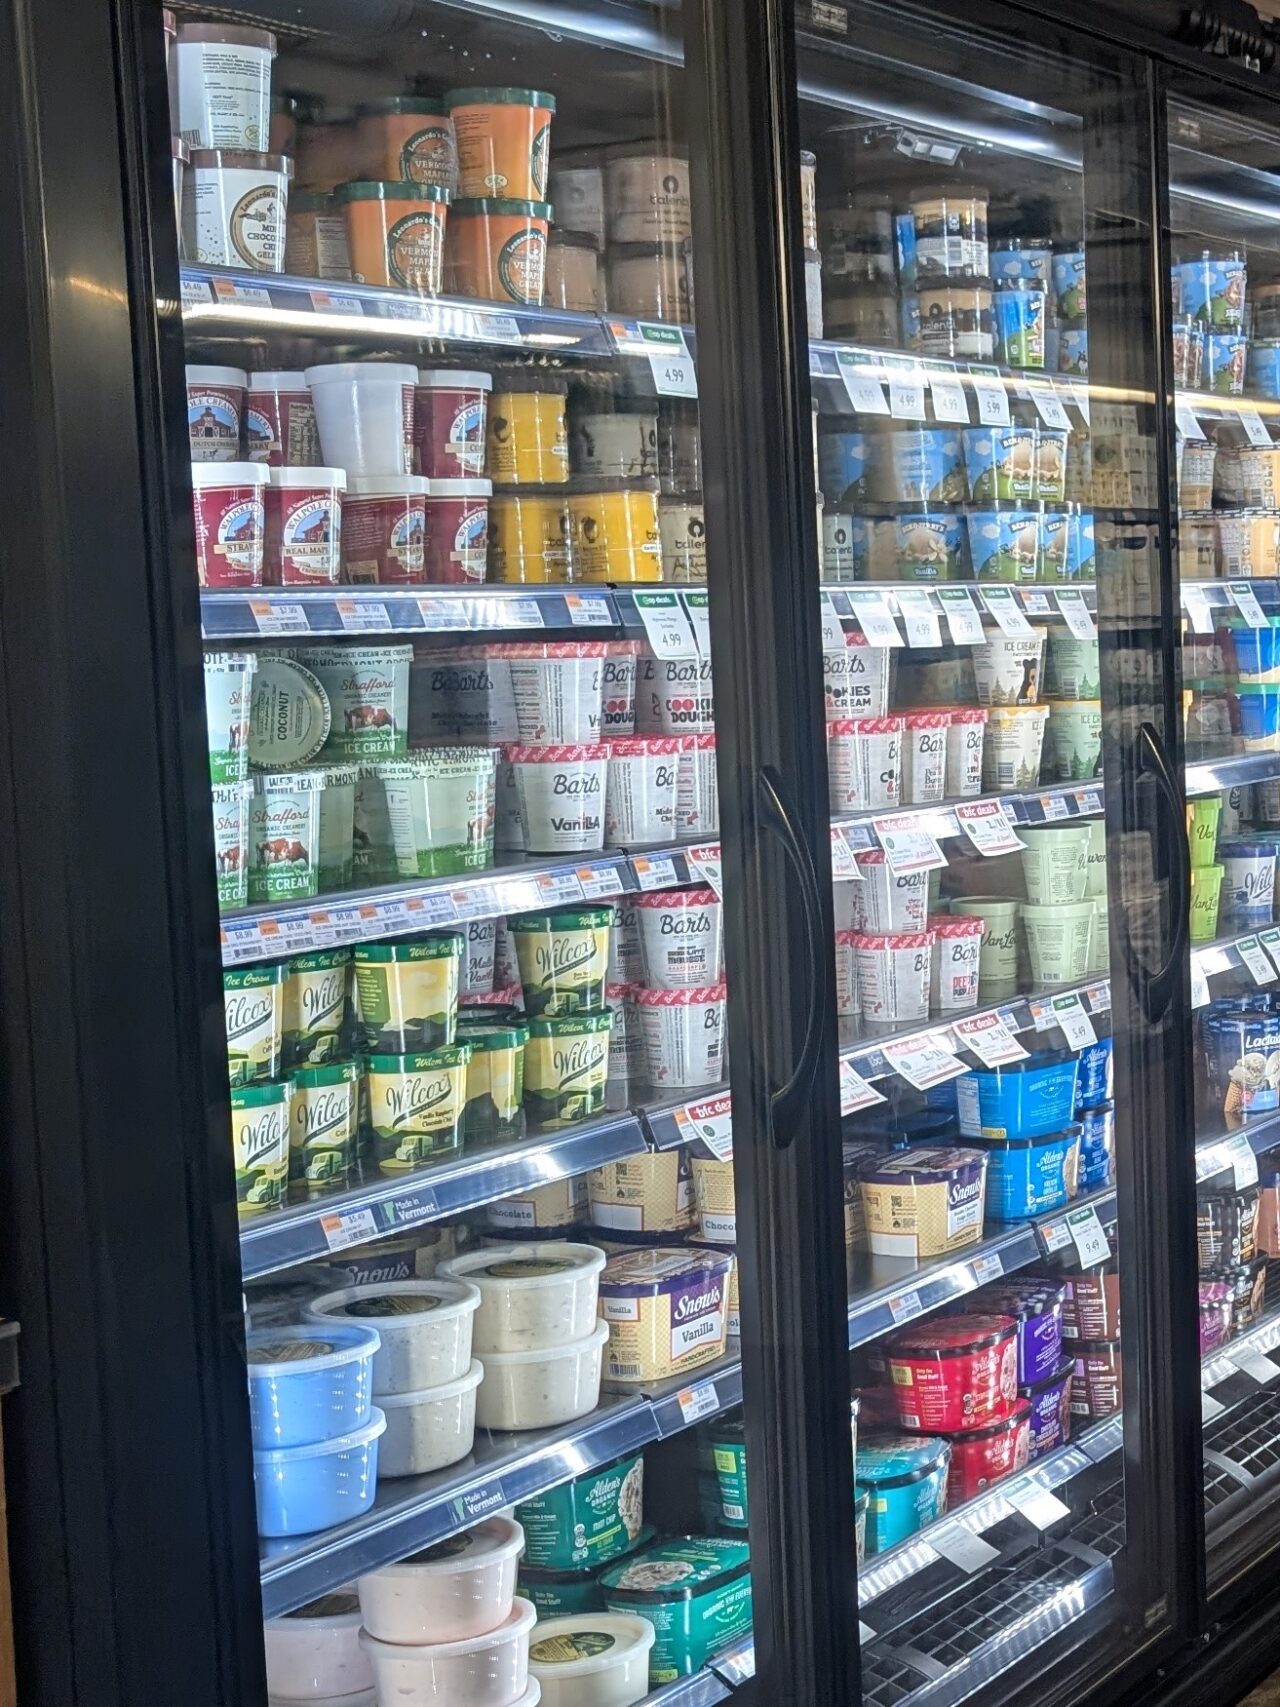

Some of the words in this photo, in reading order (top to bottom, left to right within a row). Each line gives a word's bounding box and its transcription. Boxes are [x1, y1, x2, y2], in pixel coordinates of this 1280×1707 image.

[665, 369, 684, 383] 4.99
[900, 396, 915, 407] 4.99
[987, 402, 1001, 414] 5.99
[220, 503, 250, 531] WALPOLE
[286, 502, 323, 531] WALPOLE
[286, 547, 308, 555] REAL
[915, 623, 931, 635] 4.99
[662, 633, 681, 646] 4.99
[1004, 642, 1015, 651] ICE
[823, 655, 865, 674] Barts
[340, 677, 396, 692] Strafford
[835, 698, 871, 708] CREAM
[277, 691, 289, 741] COCONUT
[671, 711, 714, 723] DOUGH
[344, 744, 361, 754] ICE
[363, 741, 396, 753] CREAM
[554, 772, 600, 795] Barts
[252, 808, 310, 824] Strafford
[963, 807, 976, 817] bfc
[977, 803, 996, 815] deals
[215, 817, 240, 831] Stra
[699, 850, 716, 861] bfc
[255, 880, 274, 892] ICE
[275, 876, 310, 891] CREAM
[660, 912, 711, 935] Barts
[225, 975, 240, 986] Ice
[243, 972, 270, 986] Cream
[963, 1021, 977, 1033] bfc
[977, 1016, 996, 1029] deals
[1073, 1026, 1087, 1037] 5.49
[695, 1105, 715, 1118] bfc
[715, 1100, 731, 1113] dea
[395, 1200, 412, 1210] Made
[398, 1203, 436, 1220] Vermont
[1085, 1240, 1100, 1254] 9.49
[345, 1260, 410, 1286] Snow's
[608, 1306, 632, 1314] Vanilla
[674, 1286, 721, 1320] Snow's
[682, 1322, 714, 1343] Vanilla
[464, 1494, 480, 1506] Made
[466, 1492, 502, 1514] Vermont
